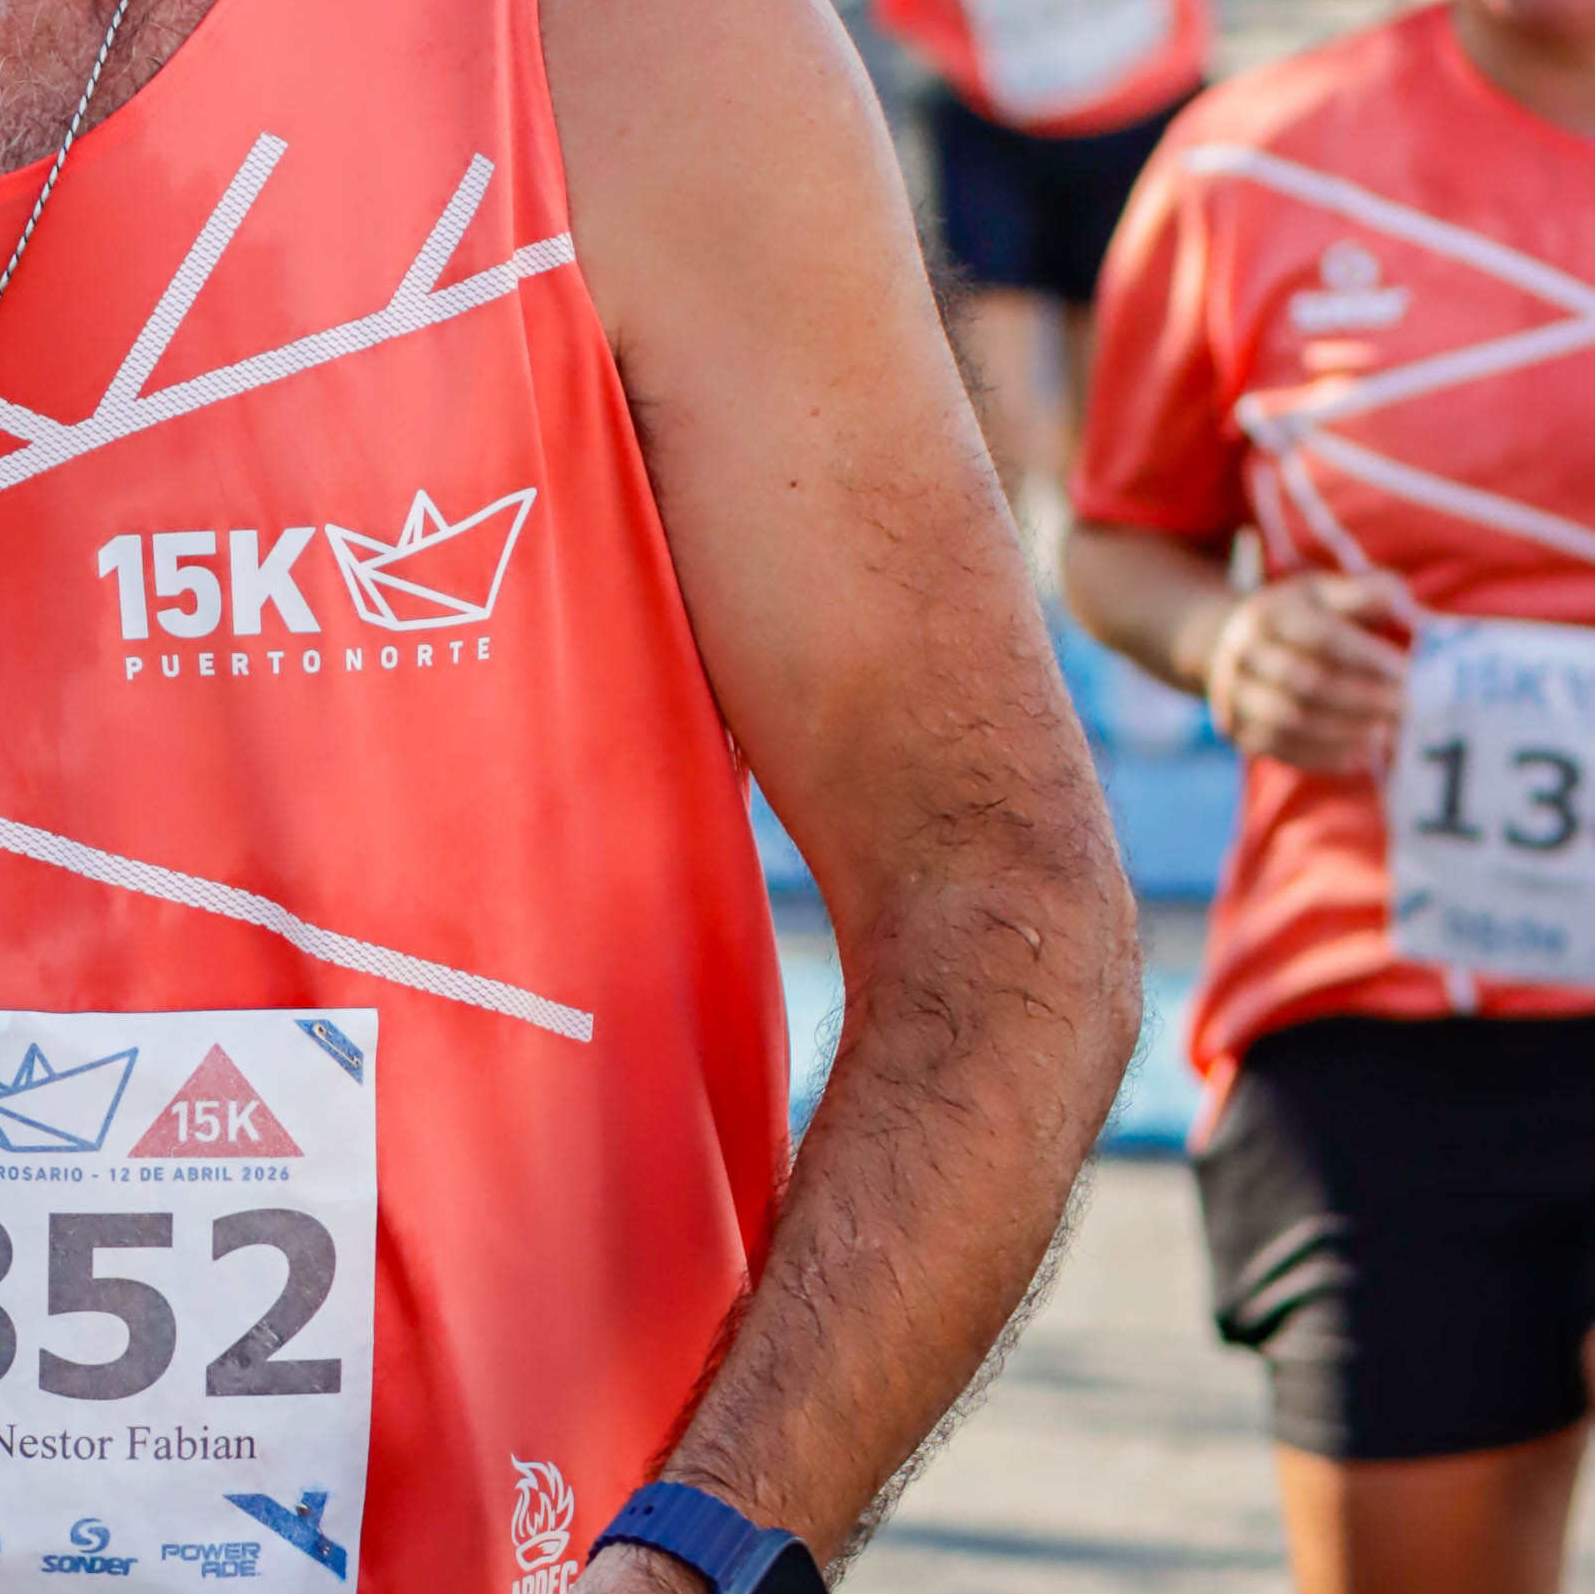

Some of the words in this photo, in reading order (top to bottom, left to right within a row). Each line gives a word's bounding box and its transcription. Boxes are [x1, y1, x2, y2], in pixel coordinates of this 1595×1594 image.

[97, 526, 322, 640] 15K
[124, 649, 321, 681] PUERTO
[345, 636, 491, 672] NORTE
[170, 1099, 261, 1143] 15K
[109, 1167, 130, 1182] 12
[139, 1166, 164, 1182] DE
[172, 1165, 233, 1182] ABRIL
[241, 1165, 290, 1182] 2026
[125, 1423, 257, 1461] Fabian
[160, 1541, 262, 1563] POWER
